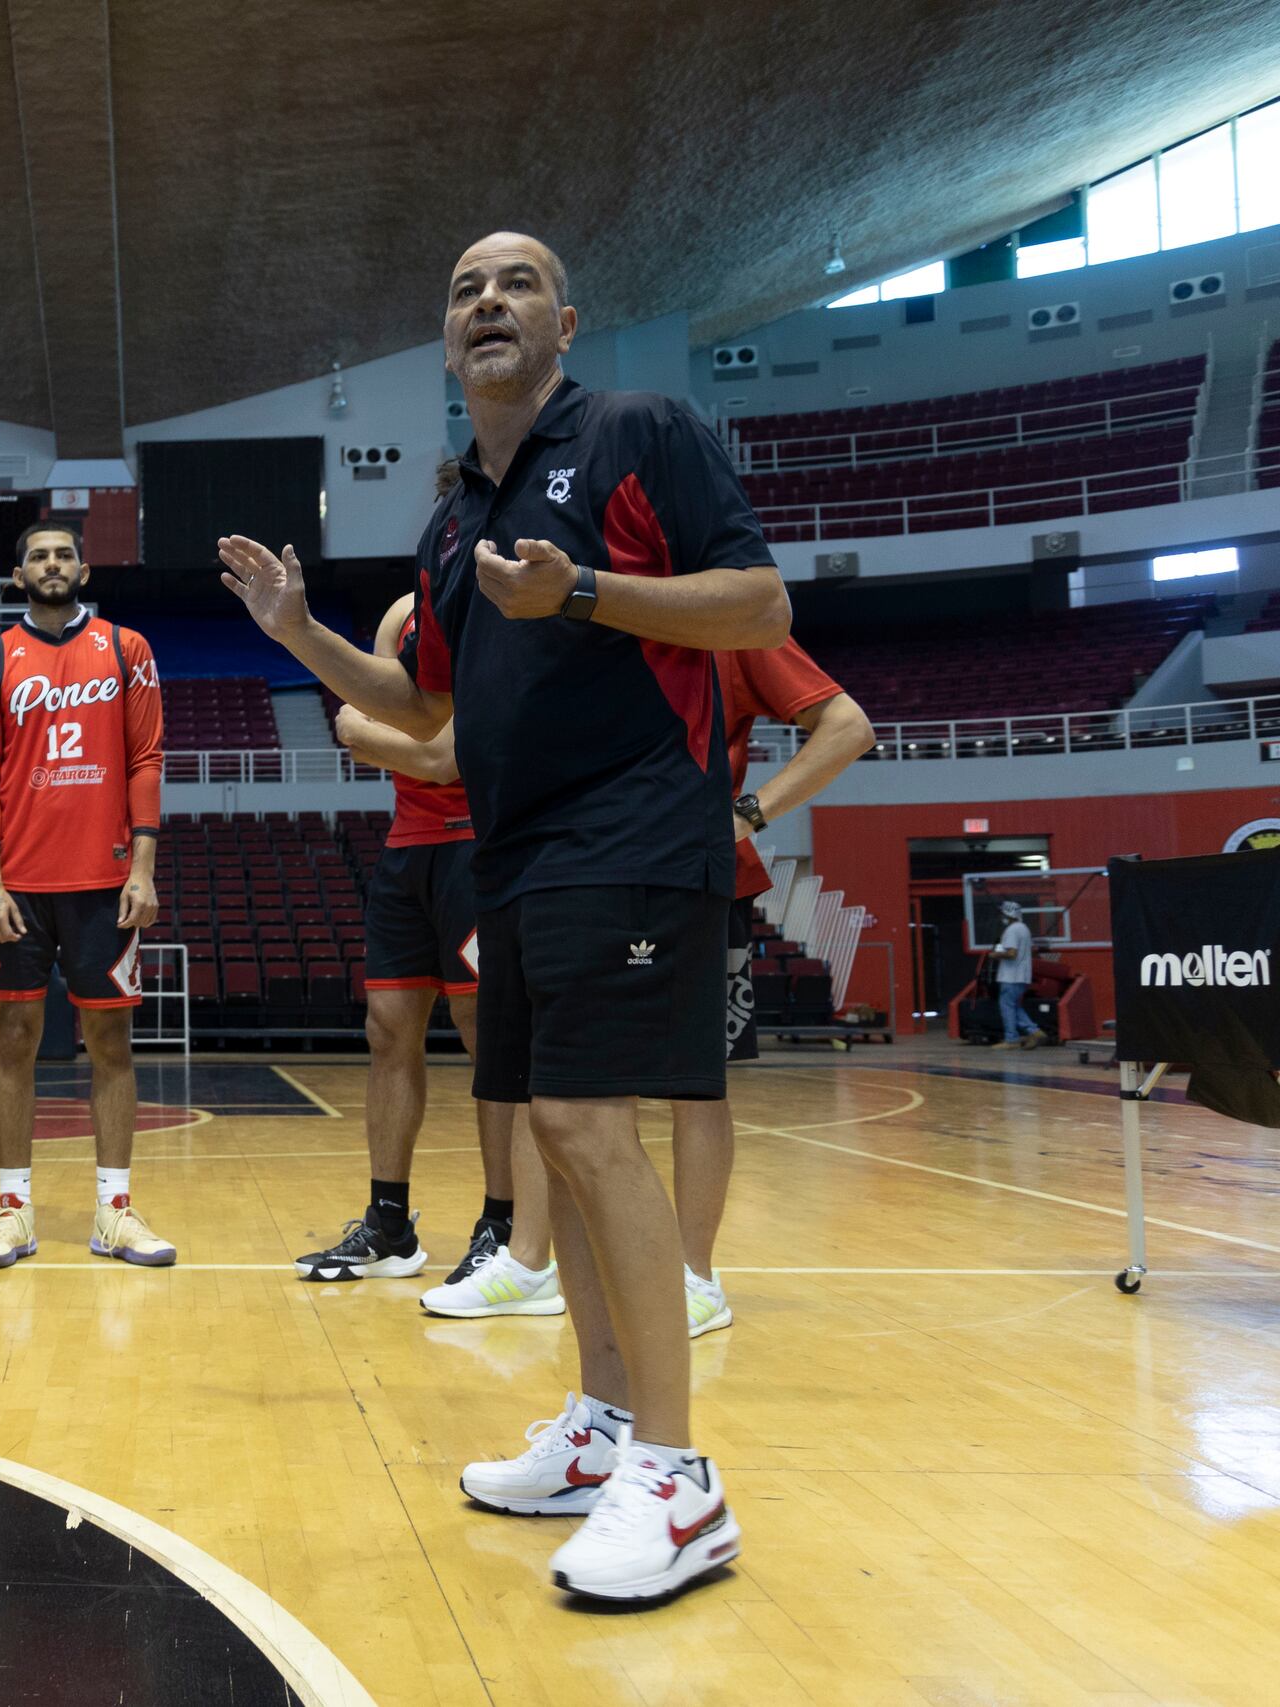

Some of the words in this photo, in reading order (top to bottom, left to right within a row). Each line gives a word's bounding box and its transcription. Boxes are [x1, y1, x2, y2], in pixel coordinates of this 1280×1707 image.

[548, 468, 576, 480] DON
[10, 675, 119, 726] Ponce
[47, 722, 83, 761] 12
[50, 767, 106, 781] TARGET
[627, 957, 653, 965] adidas
[1141, 945, 1270, 987] molten
